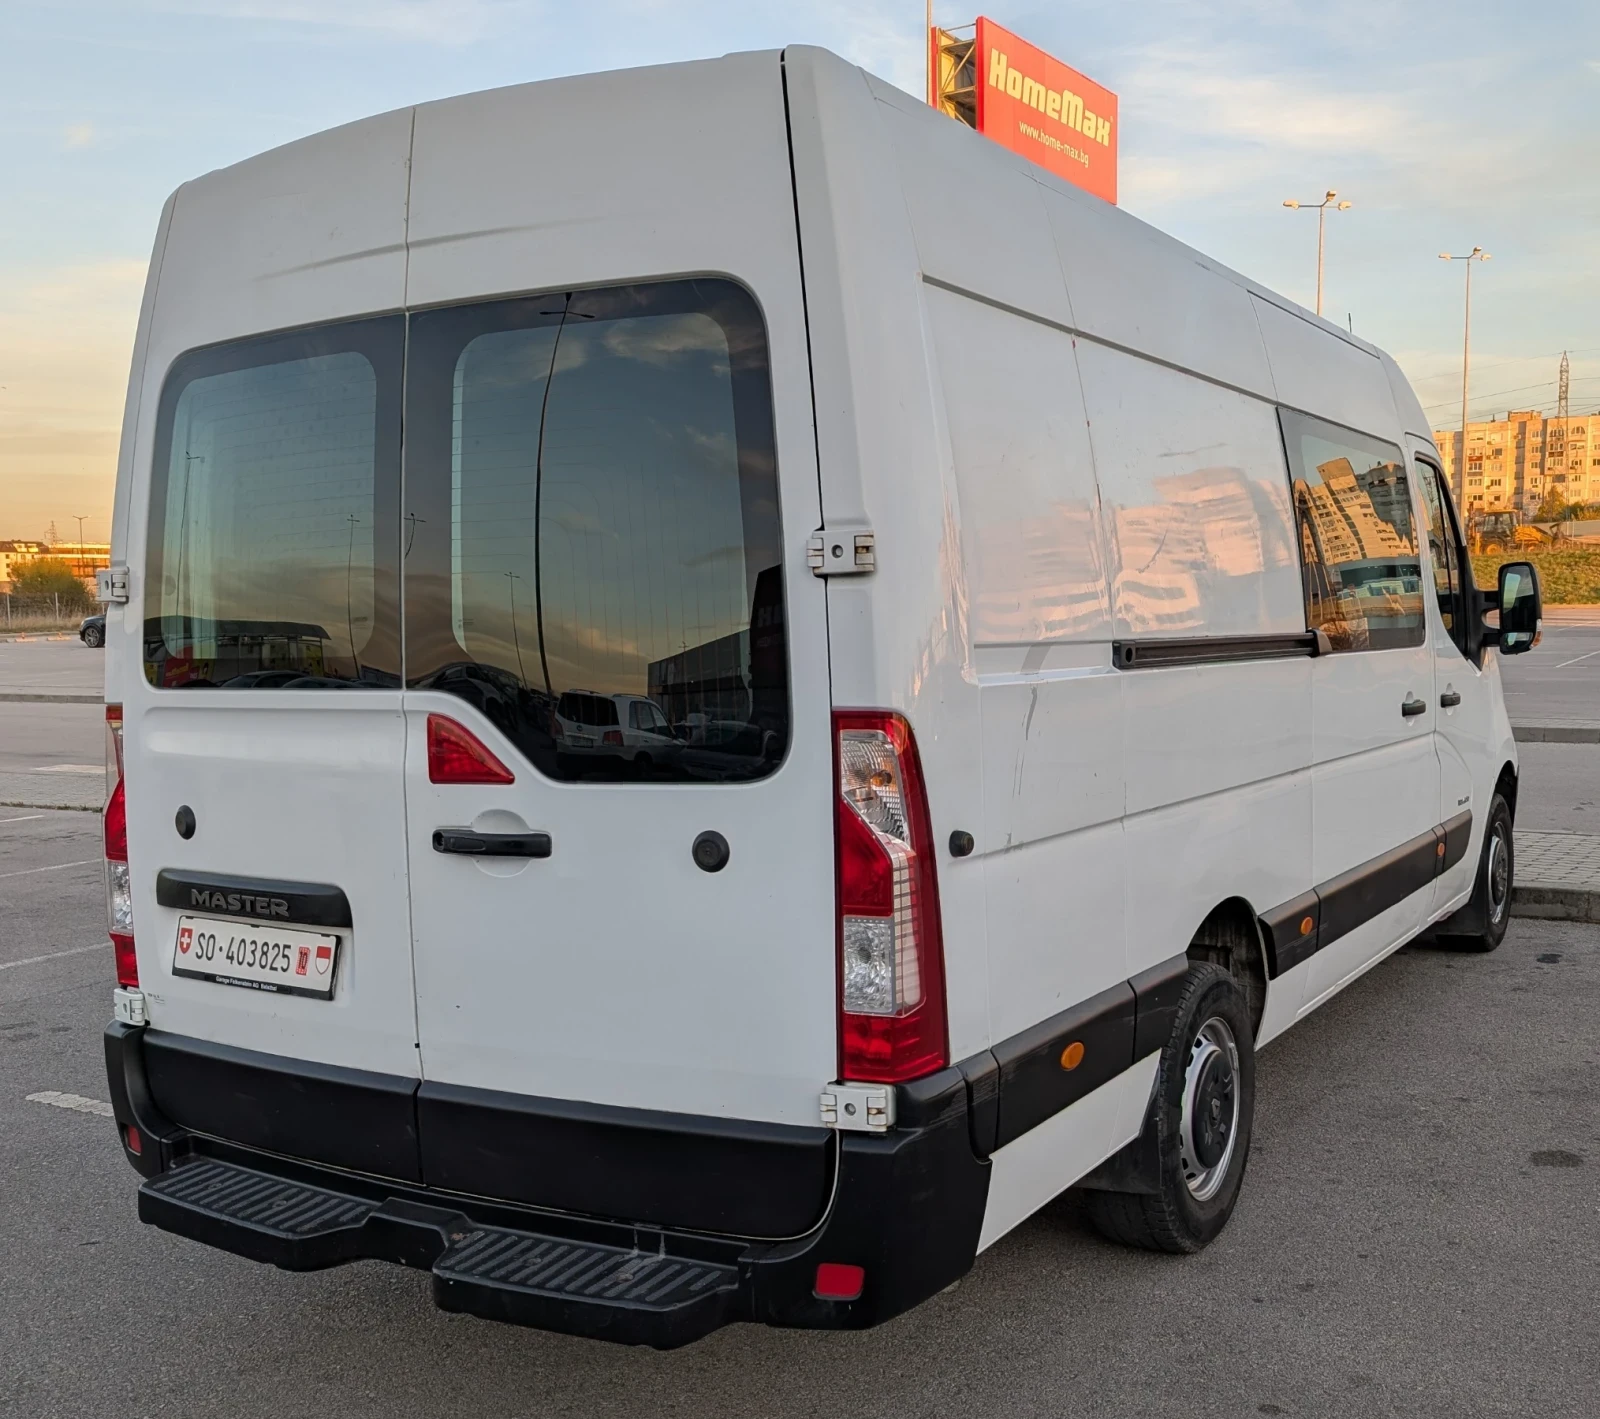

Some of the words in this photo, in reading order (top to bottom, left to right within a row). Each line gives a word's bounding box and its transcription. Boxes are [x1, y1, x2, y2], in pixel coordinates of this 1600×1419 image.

[988, 48, 1111, 147] HomeMax
[1019, 120, 1089, 168] www.home-max.bg
[191, 888, 290, 917] MASTER
